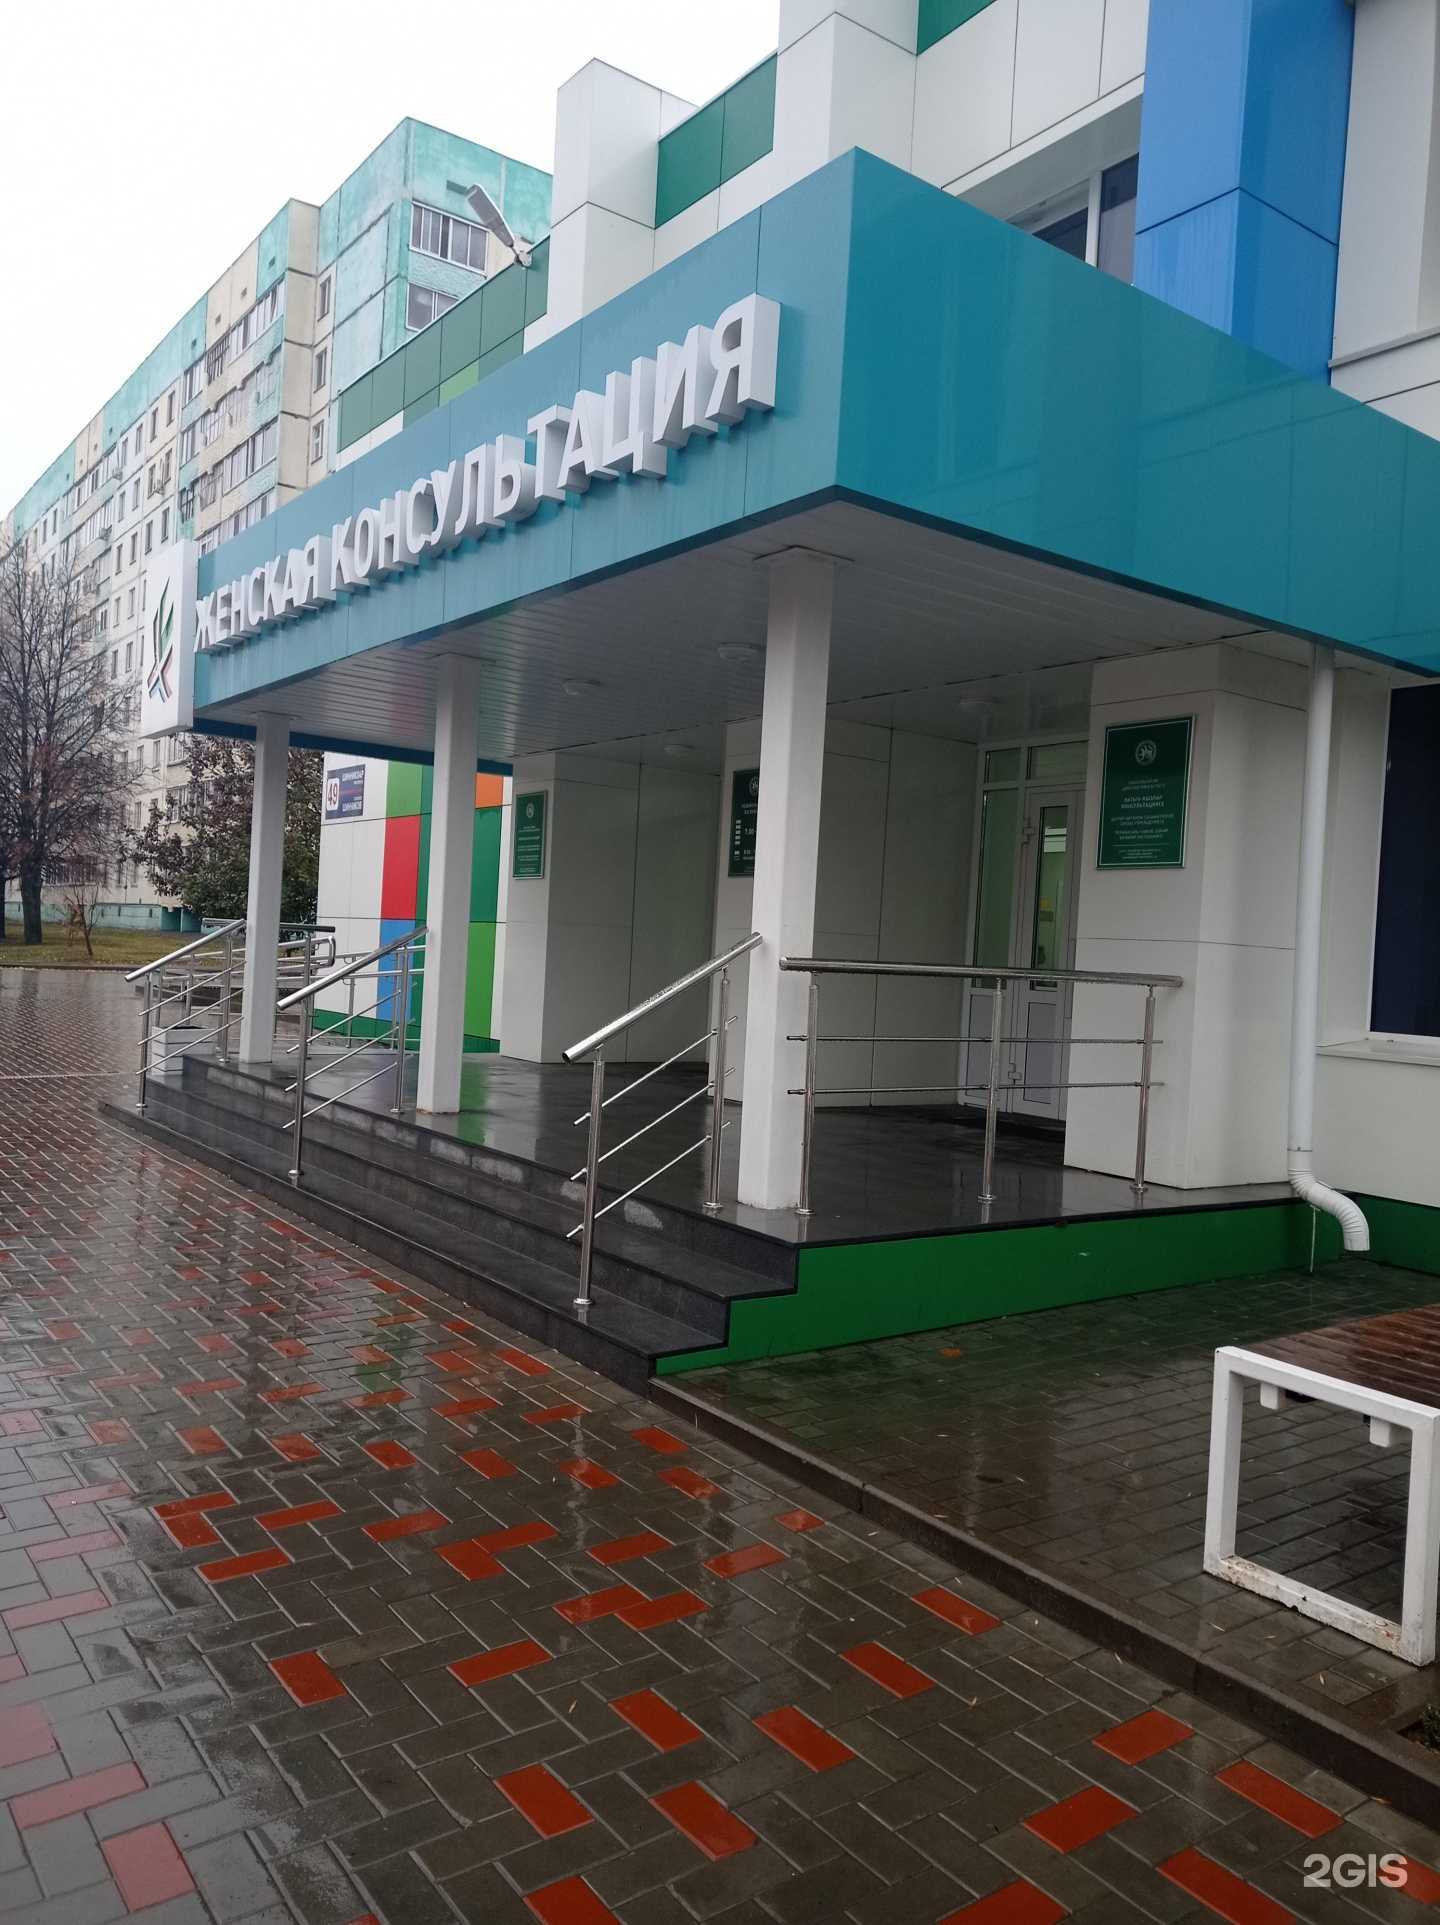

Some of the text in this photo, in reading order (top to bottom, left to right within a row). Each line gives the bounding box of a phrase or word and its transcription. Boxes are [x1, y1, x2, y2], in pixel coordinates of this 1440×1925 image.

[194, 293, 781, 655] ЖЕНСКАЯ КОНСУЛЬТАЦИЯ
[328, 783, 338, 806] 49
